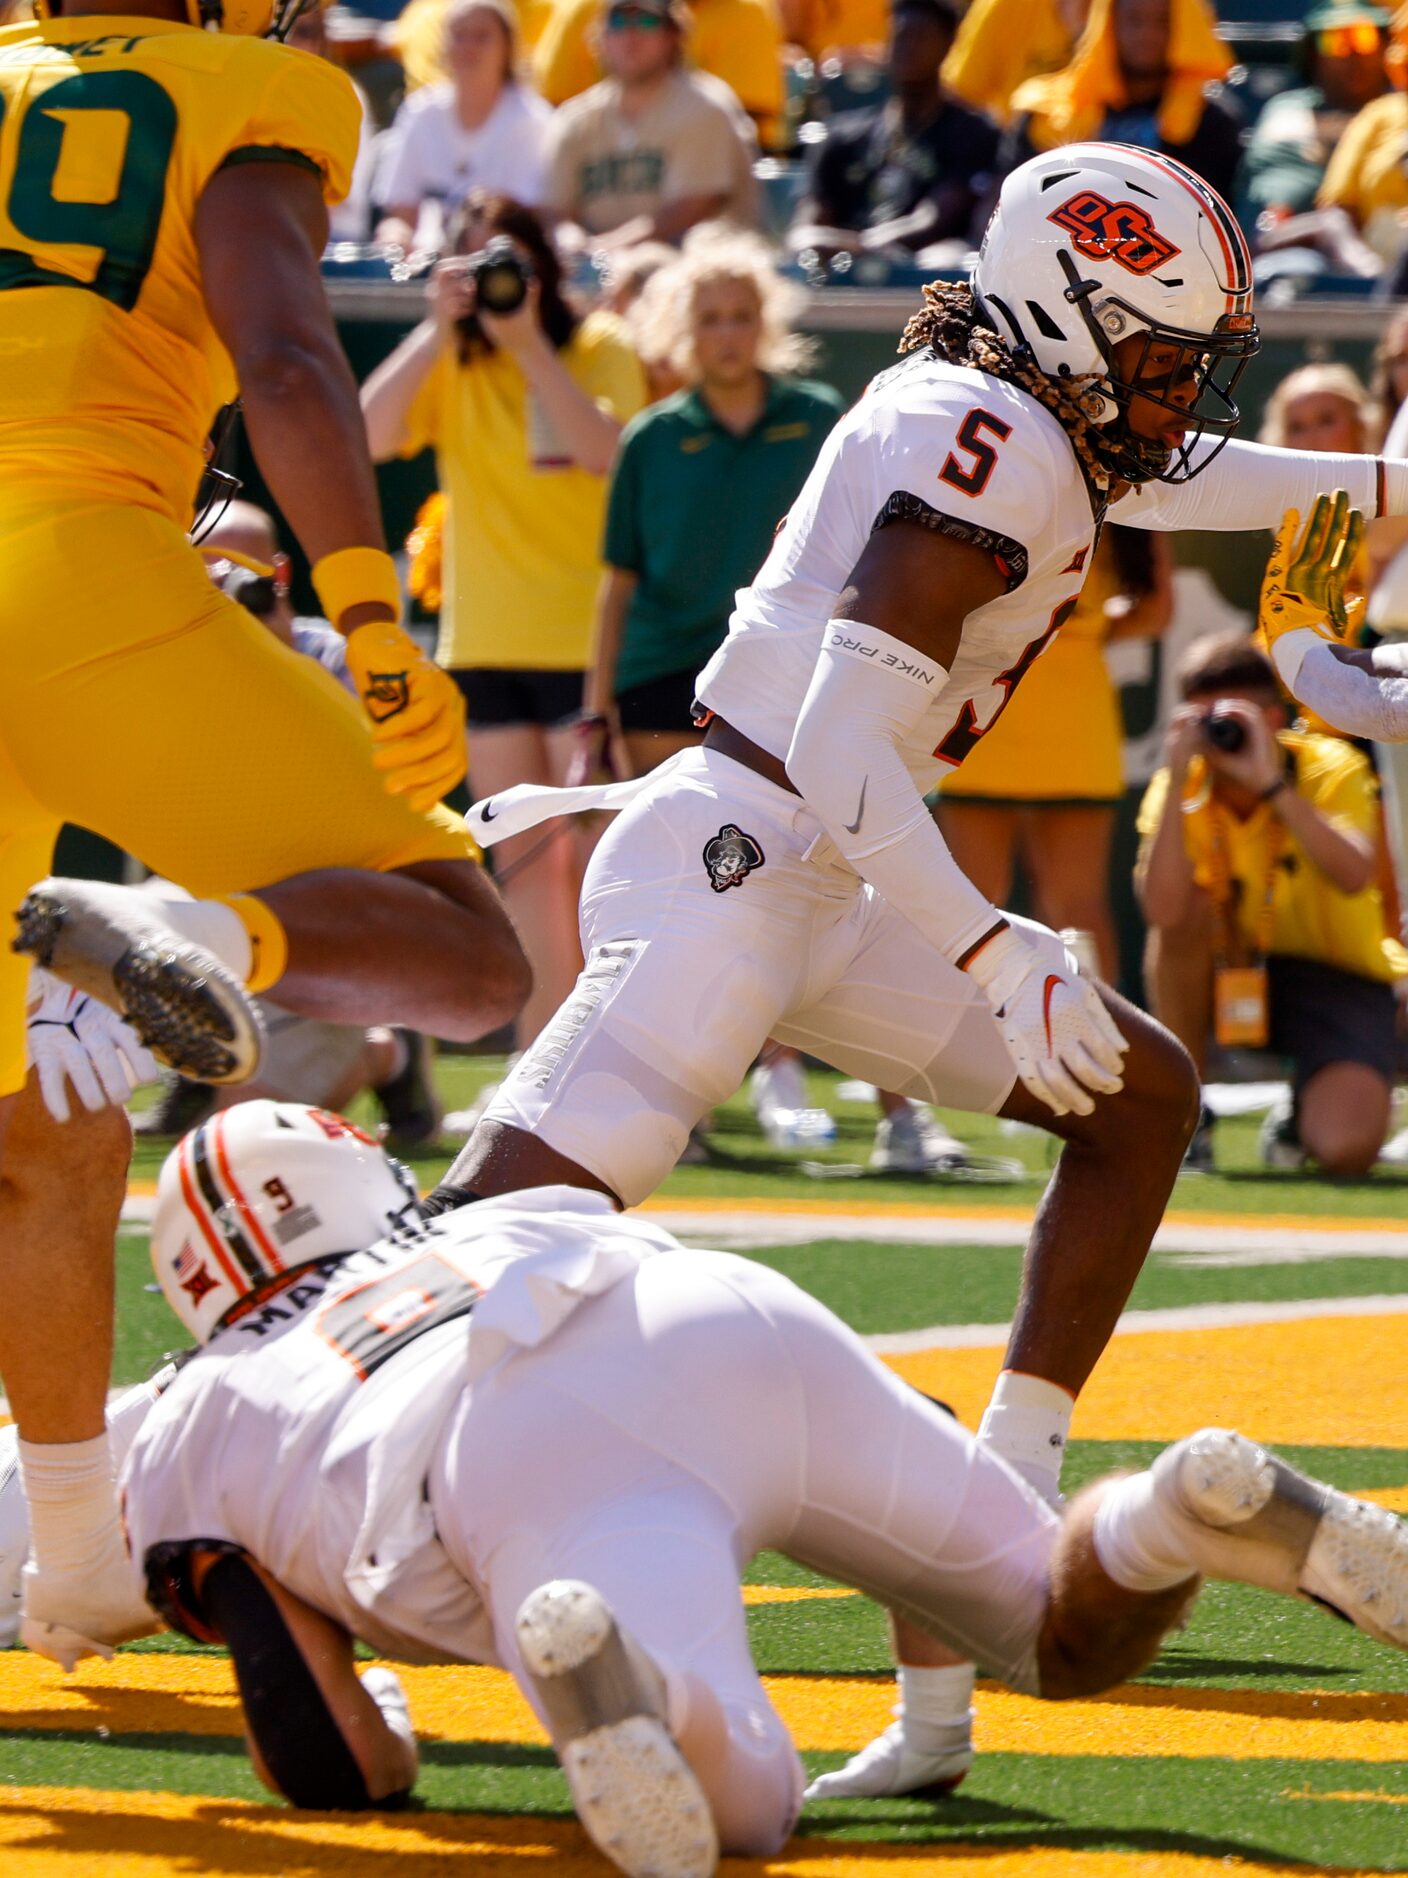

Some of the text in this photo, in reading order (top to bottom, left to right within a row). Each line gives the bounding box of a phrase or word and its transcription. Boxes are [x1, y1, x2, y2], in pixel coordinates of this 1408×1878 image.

[0, 69, 178, 313] 9
[830, 634, 935, 685] NIKE PRO
[262, 1176, 295, 1213] 9
